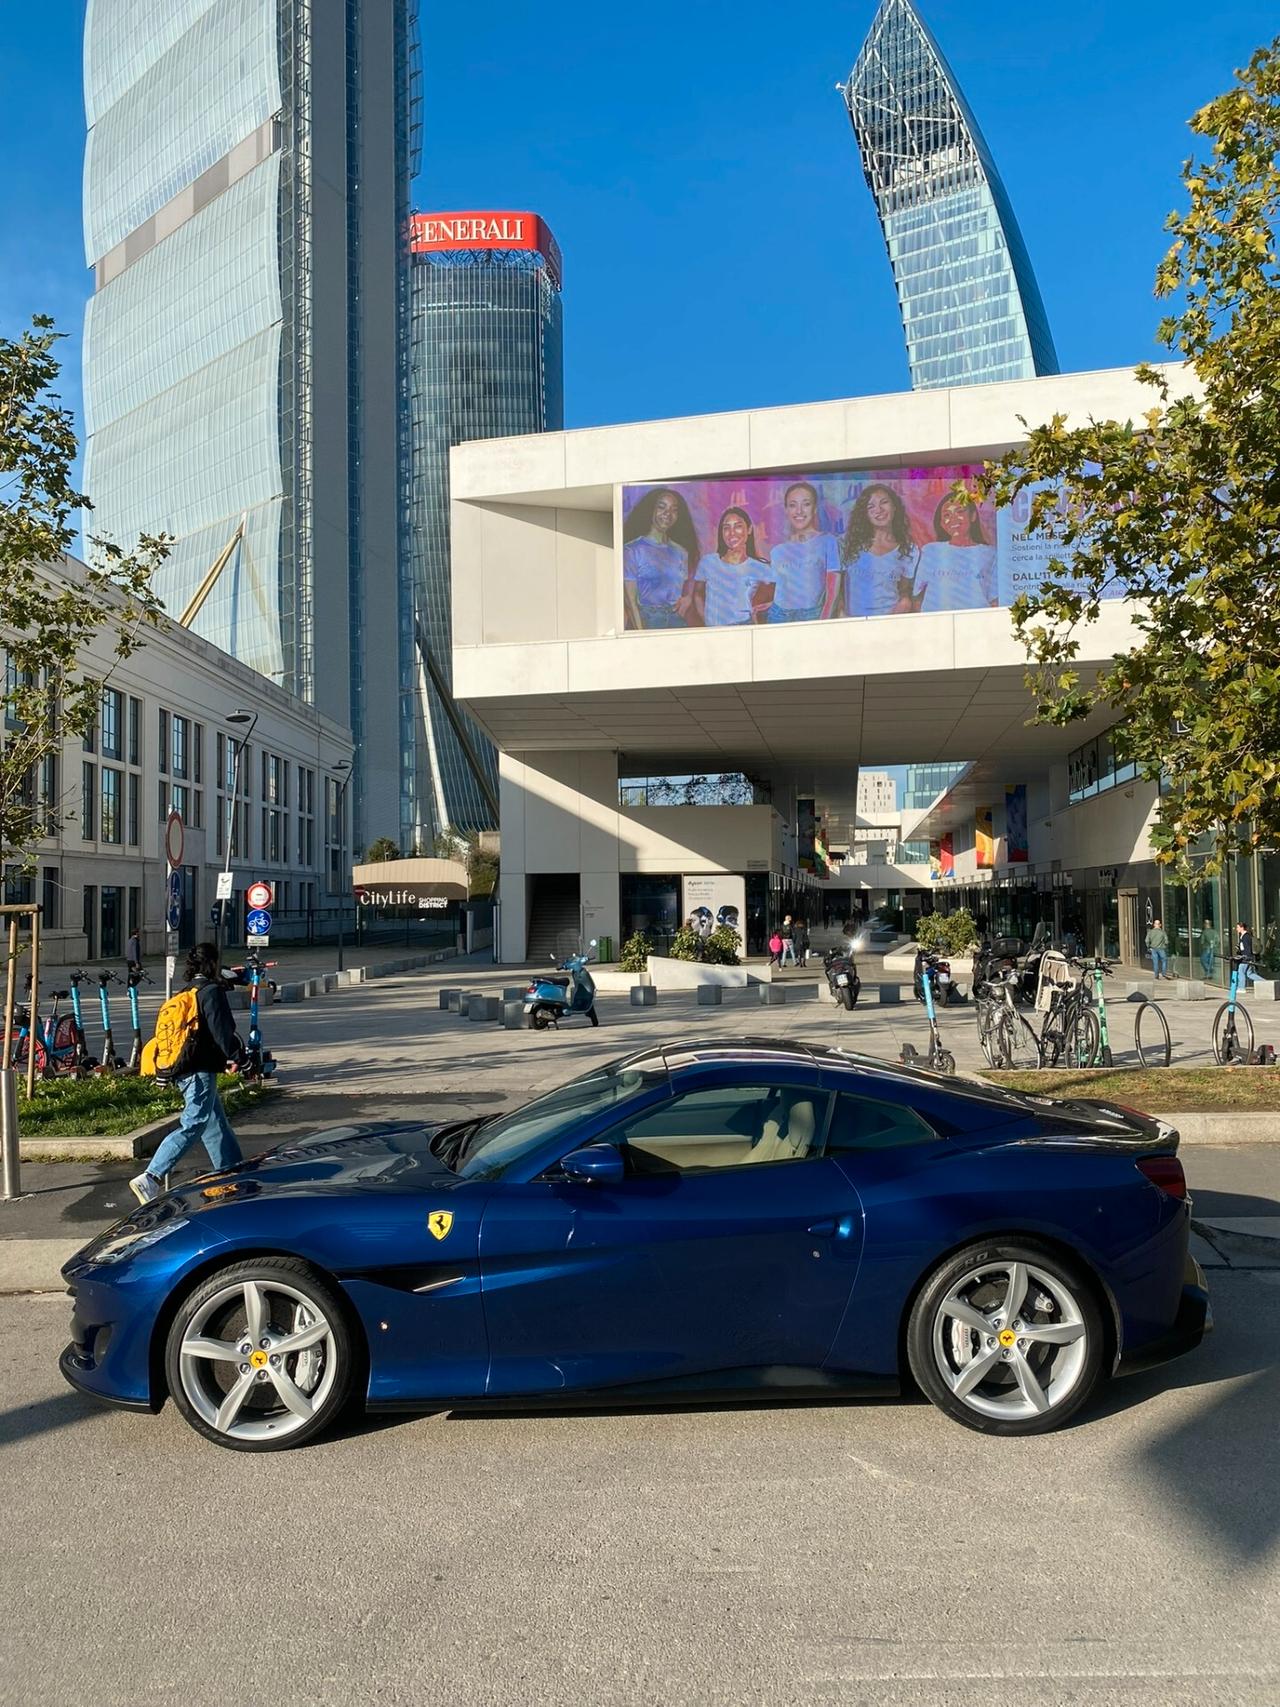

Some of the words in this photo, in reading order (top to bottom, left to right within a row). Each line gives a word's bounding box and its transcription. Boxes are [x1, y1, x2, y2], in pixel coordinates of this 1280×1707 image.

[410, 218, 524, 244] GENERALI
[1011, 533, 1033, 542] NEL
[360, 890, 416, 908] CityLife
